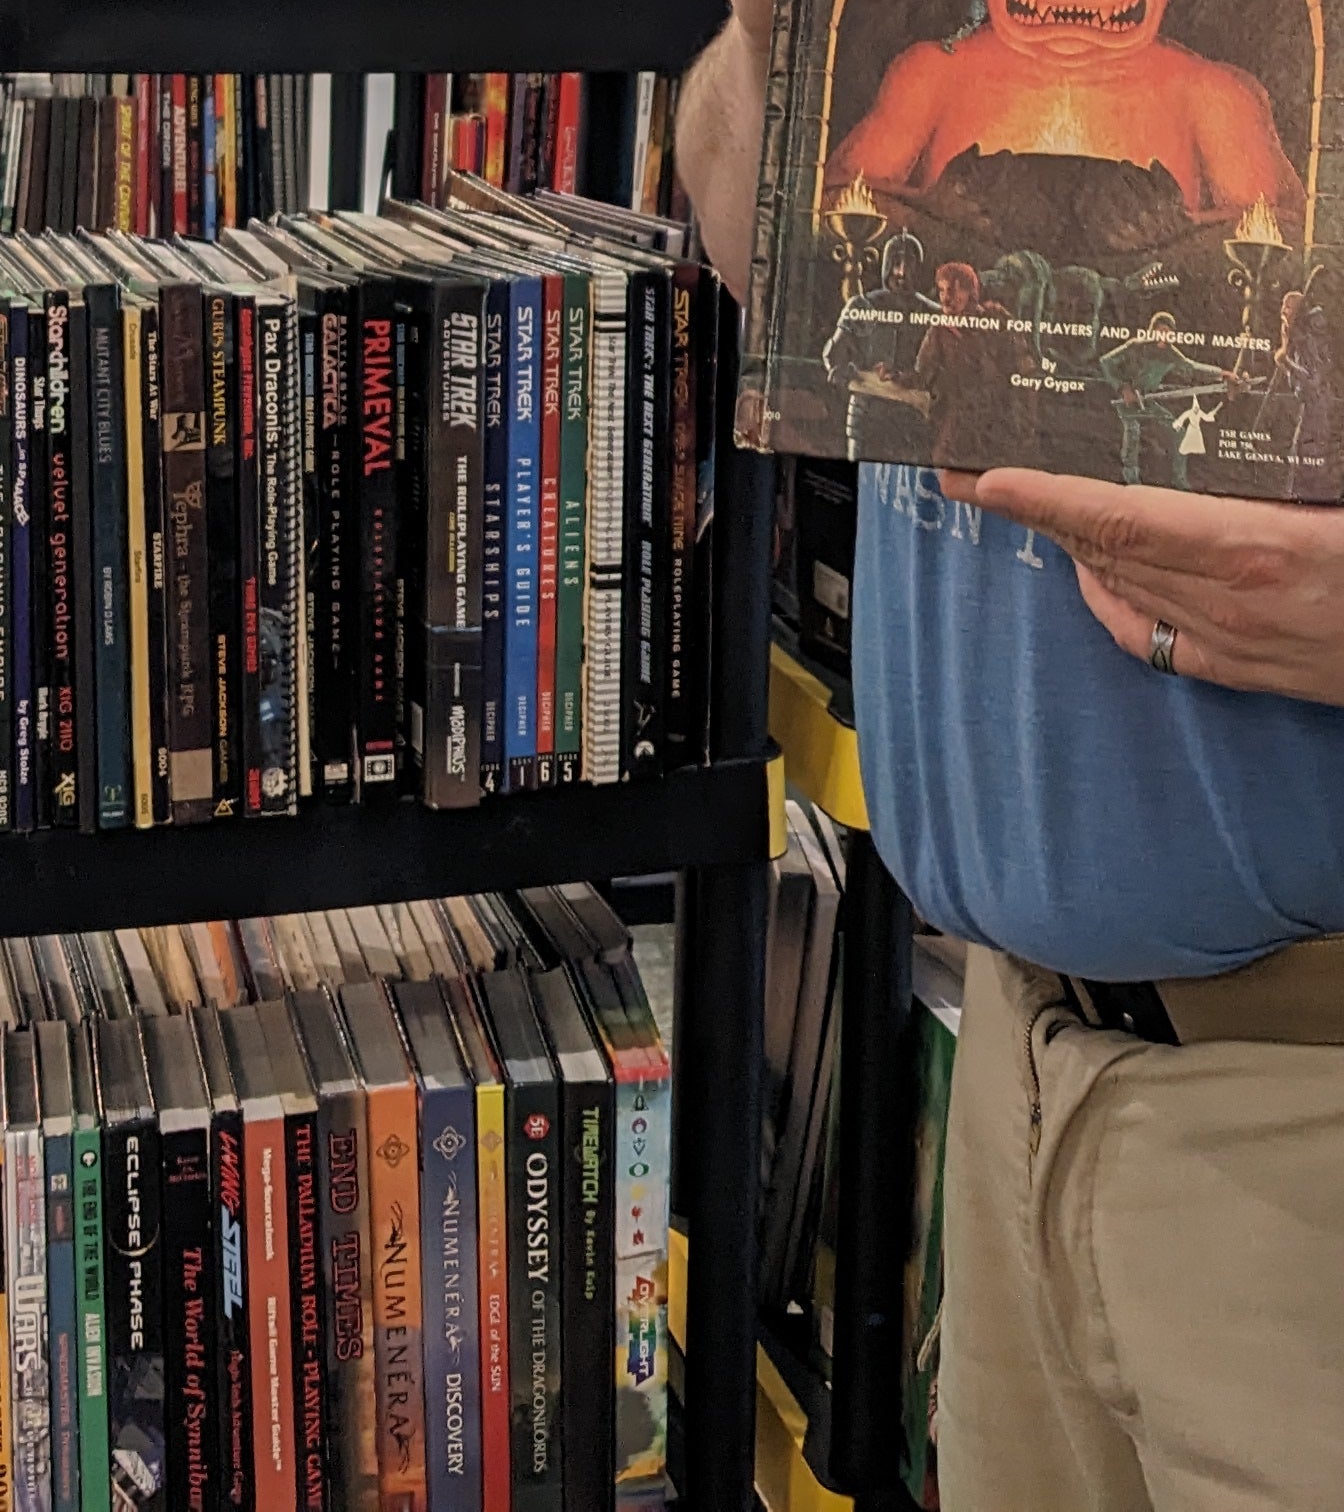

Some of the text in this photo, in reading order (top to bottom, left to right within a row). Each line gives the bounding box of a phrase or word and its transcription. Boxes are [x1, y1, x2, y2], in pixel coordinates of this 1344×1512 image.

[120, 142, 130, 157] OF
[162, 91, 171, 119] THE
[120, 162, 131, 182] THE
[323, 313, 337, 429] GALACTICA
[442, 319, 450, 421] ADVENTURES
[450, 313, 476, 431] STAR TREK
[840, 307, 1272, 352] COMPILED INFORMATION FOR PLAYERS AND DUNGEON MASTERS
[1010, 374, 1086, 395] Gary Gygax
[1040, 356, 1057, 373] By
[96, 328, 112, 463] MUTANT CITY BLUES
[363, 319, 392, 476] PRIMEVAL
[564, 307, 583, 588] STAR TREK ALIENS
[1240, 431, 1271, 441] GAMES
[484, 313, 501, 619] STAR TREK STARSHIPS
[515, 306, 533, 626] STAR TREK PLAYER'S GUIDE
[541, 310, 560, 600] STAR TREK CREATURES
[1218, 450, 1299, 464] LAKE GENEVA, WI
[16, 699, 29, 785] by Greg Stolze
[125, 1135, 144, 1351] ECLIPSE PHASE
[328, 1131, 364, 1362] END TIMES
[181, 1246, 206, 1396] The World of
[525, 1152, 549, 1473] ODYSSEY OF THE DRAGONLORDS
